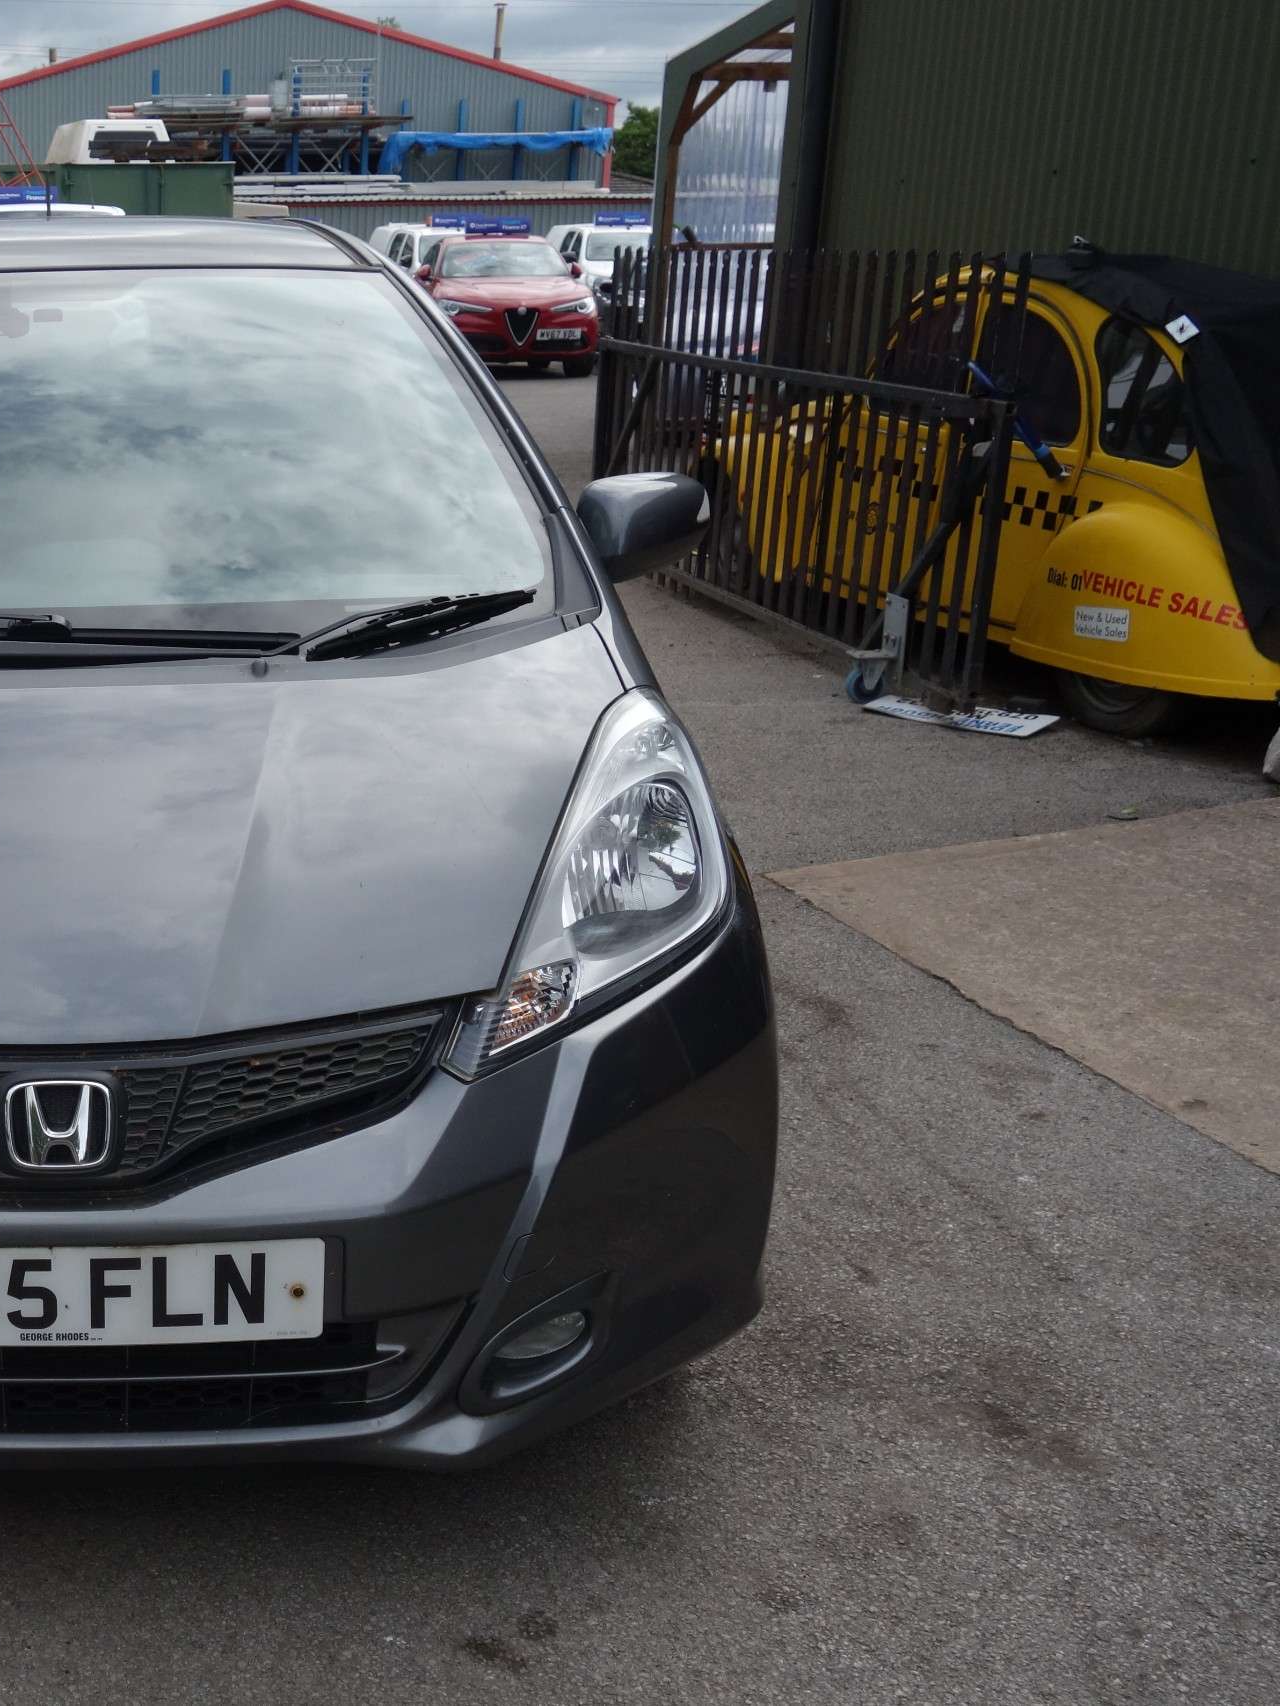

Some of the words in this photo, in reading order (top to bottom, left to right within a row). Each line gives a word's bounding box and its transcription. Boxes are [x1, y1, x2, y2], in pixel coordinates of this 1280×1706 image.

[1047, 567, 1068, 588] Dial:
[1081, 569, 1164, 608] VEHICLE
[1168, 592, 1251, 630] SALES
[1076, 611, 1094, 622] New
[1097, 612, 1102, 623] &
[1105, 613, 1127, 625] Used
[1075, 624, 1102, 637] Vehicle
[1105, 626, 1127, 639] Sales
[89, 1253, 266, 1329] FLN
[20, 1332, 53, 1341] GEORGE
[55, 1332, 89, 1341] RHODES
